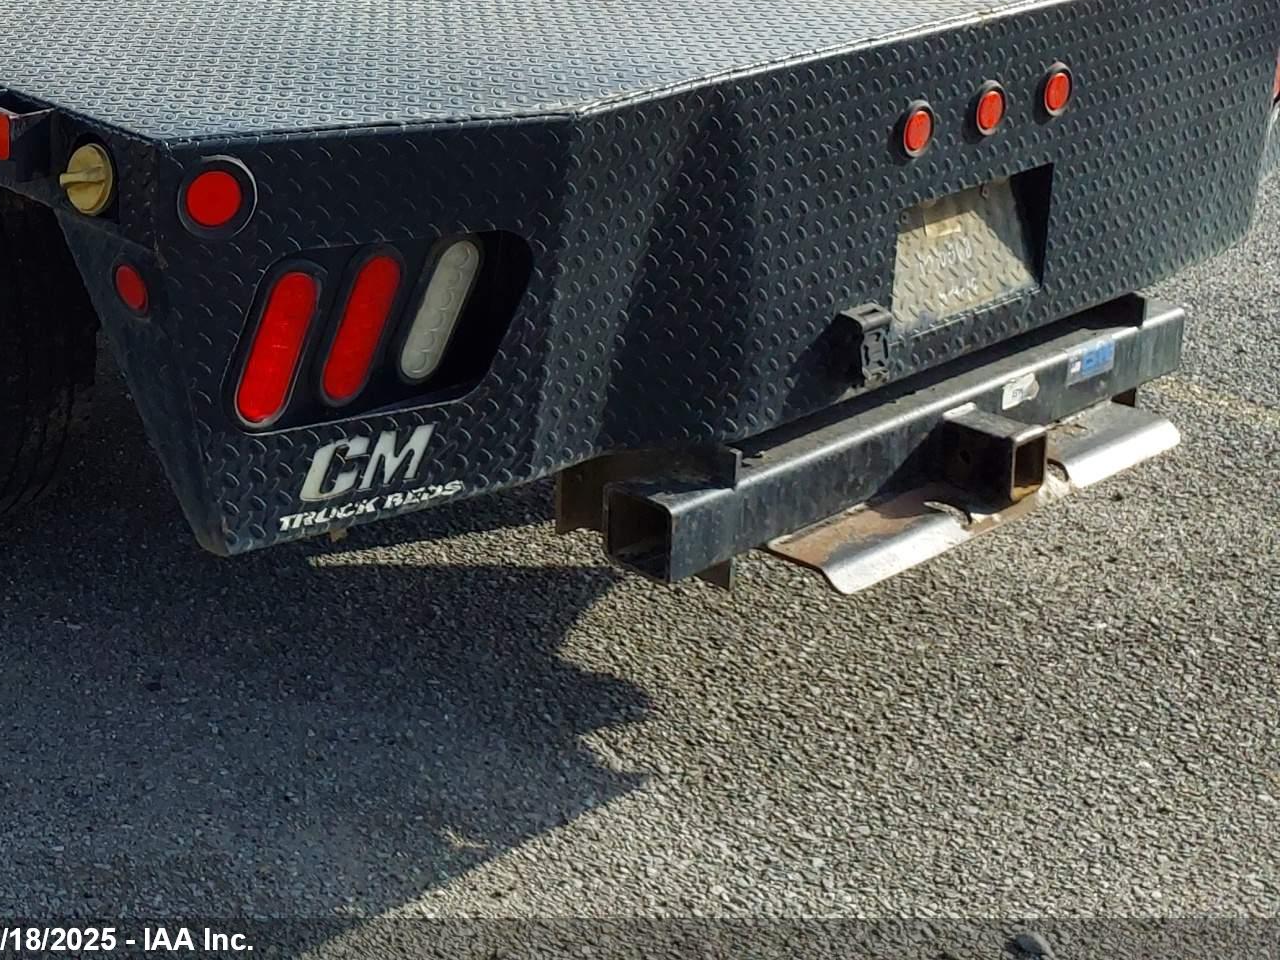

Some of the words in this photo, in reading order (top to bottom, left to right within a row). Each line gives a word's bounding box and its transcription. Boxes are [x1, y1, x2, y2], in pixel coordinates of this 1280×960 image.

[300, 423, 437, 502] CM
[278, 496, 380, 531] TRUCK
[383, 479, 466, 509] BEDS
